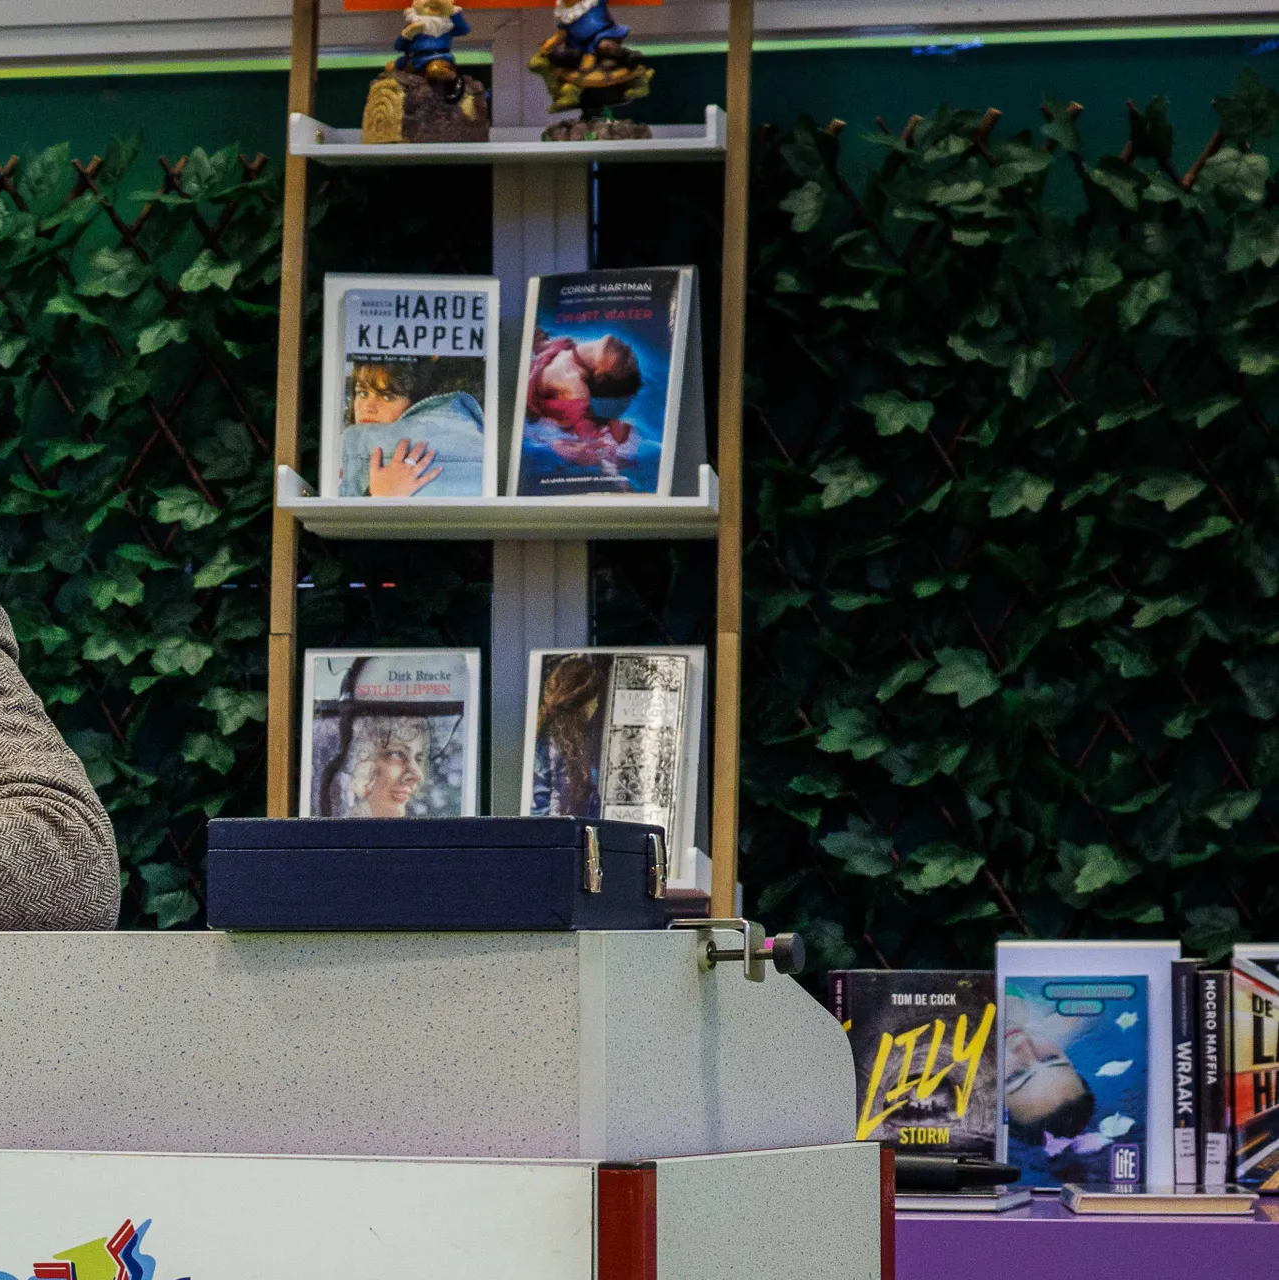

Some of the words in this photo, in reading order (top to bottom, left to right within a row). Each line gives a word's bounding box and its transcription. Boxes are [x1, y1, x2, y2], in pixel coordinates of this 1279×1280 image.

[599, 282, 653, 293] HARTMAN
[395, 294, 485, 321] HARDE
[603, 307, 653, 321] WATER
[358, 324, 484, 350] KLAPPEN
[388, 670, 413, 682] Dirk
[415, 670, 453, 681] Bracke
[356, 684, 402, 697] STILLE
[405, 683, 451, 697] LIPPEN
[891, 993, 913, 1006] TOM
[914, 993, 928, 1006] DE
[930, 993, 957, 1006] COCK
[1205, 979, 1217, 1031] MOCRO
[1252, 992, 1274, 1018] DE
[856, 1002, 997, 1141] LILY
[1176, 1040, 1194, 1115] WRAAK
[899, 1126, 950, 1145] STORM
